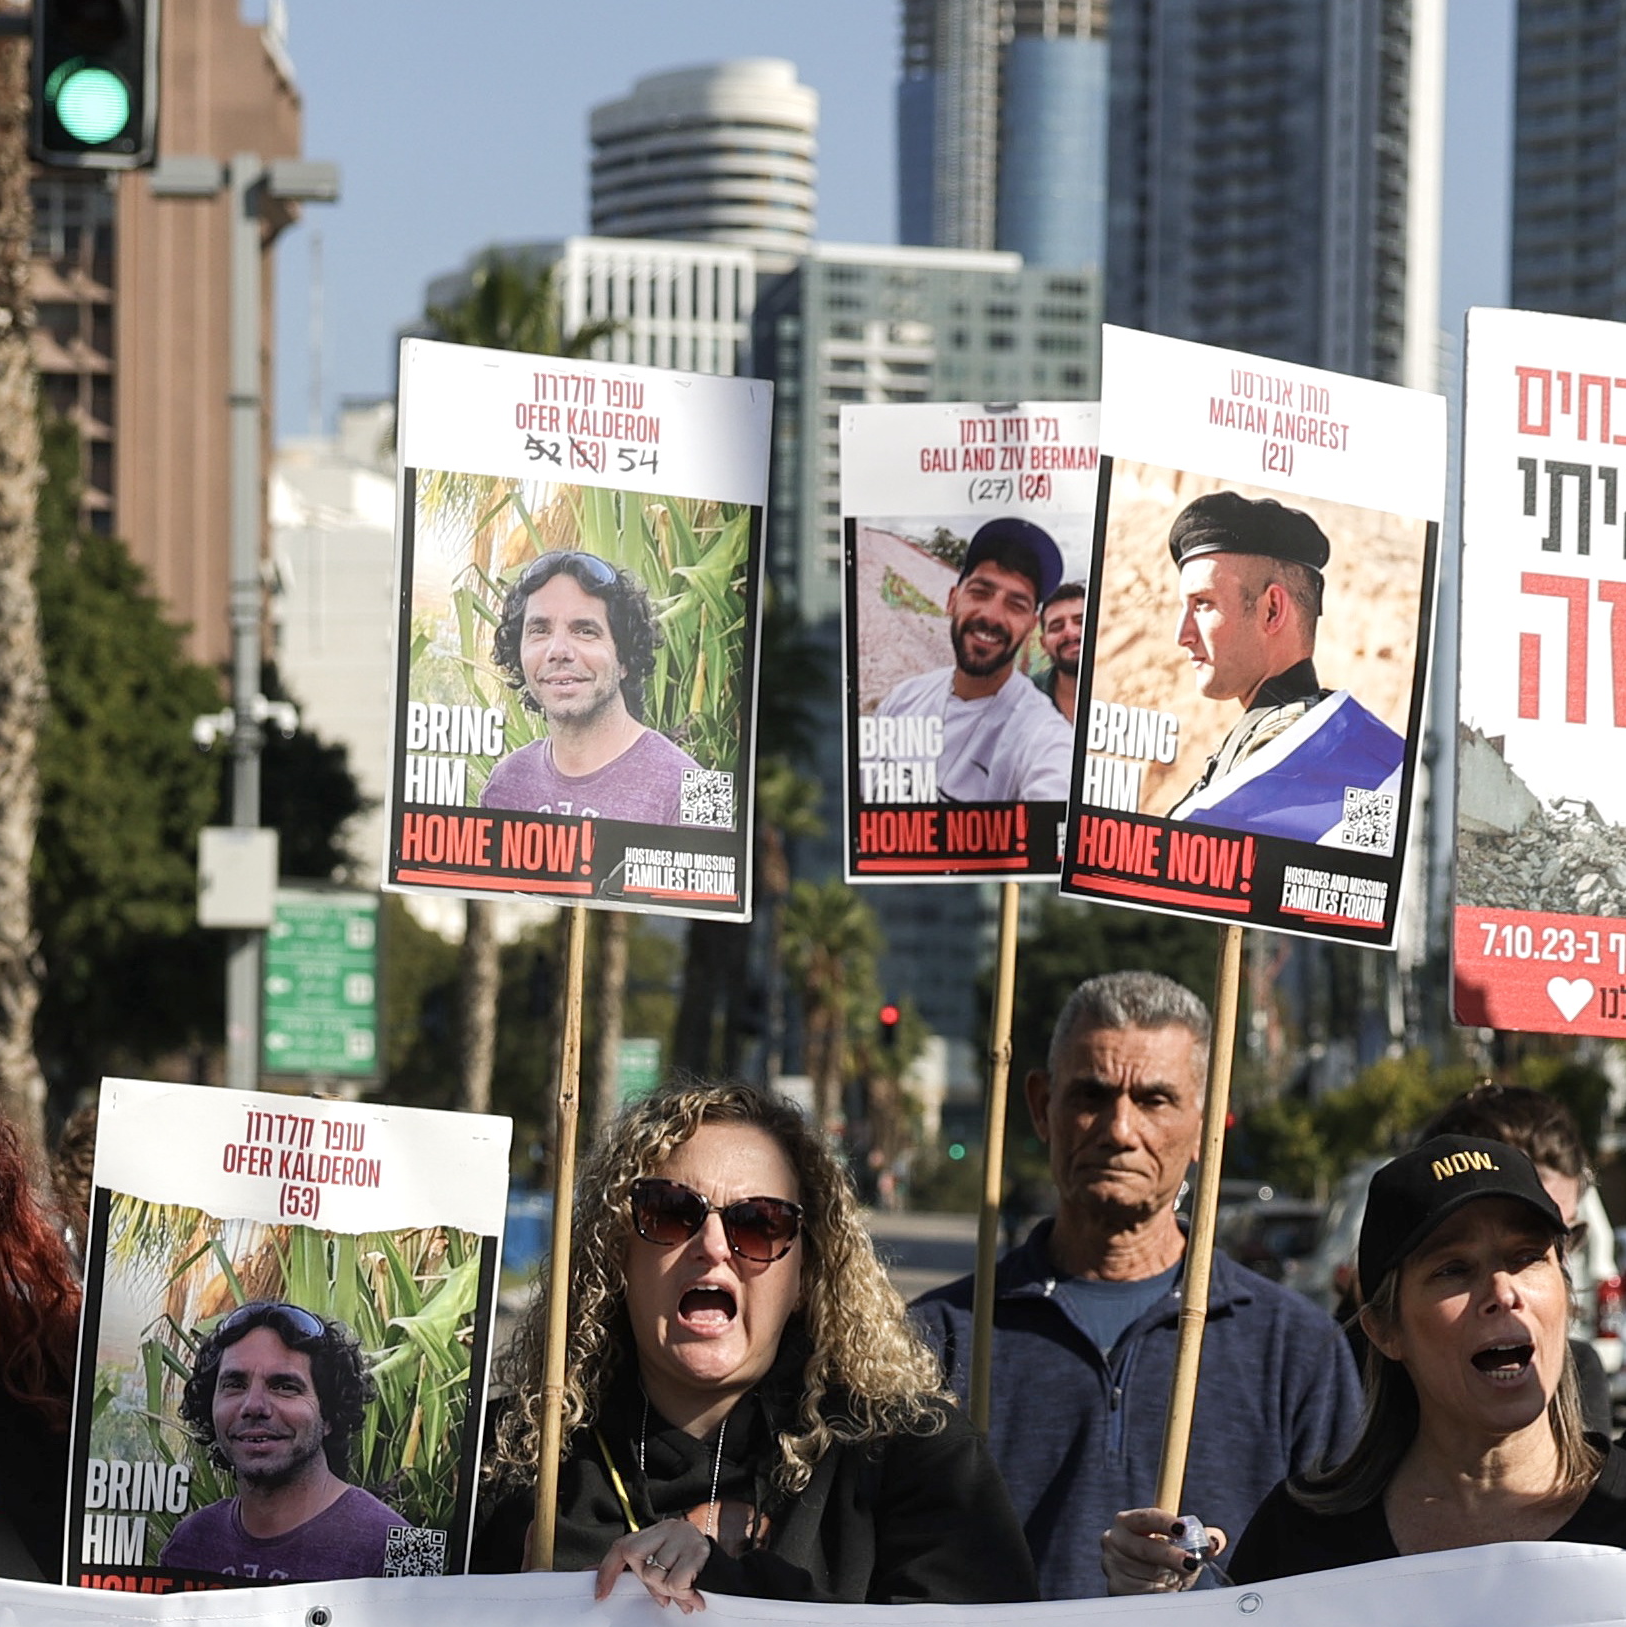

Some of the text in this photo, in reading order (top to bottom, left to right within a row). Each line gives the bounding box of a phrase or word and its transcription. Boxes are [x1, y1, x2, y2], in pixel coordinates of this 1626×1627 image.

[534, 372, 644, 410] עופר קלדרון
[1230, 368, 1330, 414] מתן אנגרסט
[516, 402, 660, 444] OFER KALDERON
[960, 416, 1060, 445] גלי וזיו ברמן
[1209, 397, 1350, 452] MATAN ANGREST
[617, 450, 659, 474] 54
[921, 446, 1098, 472] GALI AND ZIV BERMAN
[1262, 441, 1294, 475] (21)
[969, 476, 1013, 503] (27)
[406, 701, 504, 757] BRING
[859, 716, 943, 759] BRING
[1087, 700, 1178, 763] BRING
[404, 754, 464, 806] HIM
[860, 760, 937, 804] THEM
[1083, 759, 1140, 813] HIM
[401, 811, 593, 875] HOME NOW!
[858, 810, 938, 853] HOME
[947, 804, 1026, 852] NOW!
[1078, 816, 1159, 876] HOME
[1169, 830, 1255, 894] NOW!
[246, 1110, 364, 1152] עופר קלדרון
[223, 1143, 381, 1188] OFER KALDERON
[1430, 1150, 1500, 1181] NOW.
[279, 1186, 320, 1220] (53)
[85, 1459, 191, 1514] BRING
[82, 1514, 147, 1566] HIM
